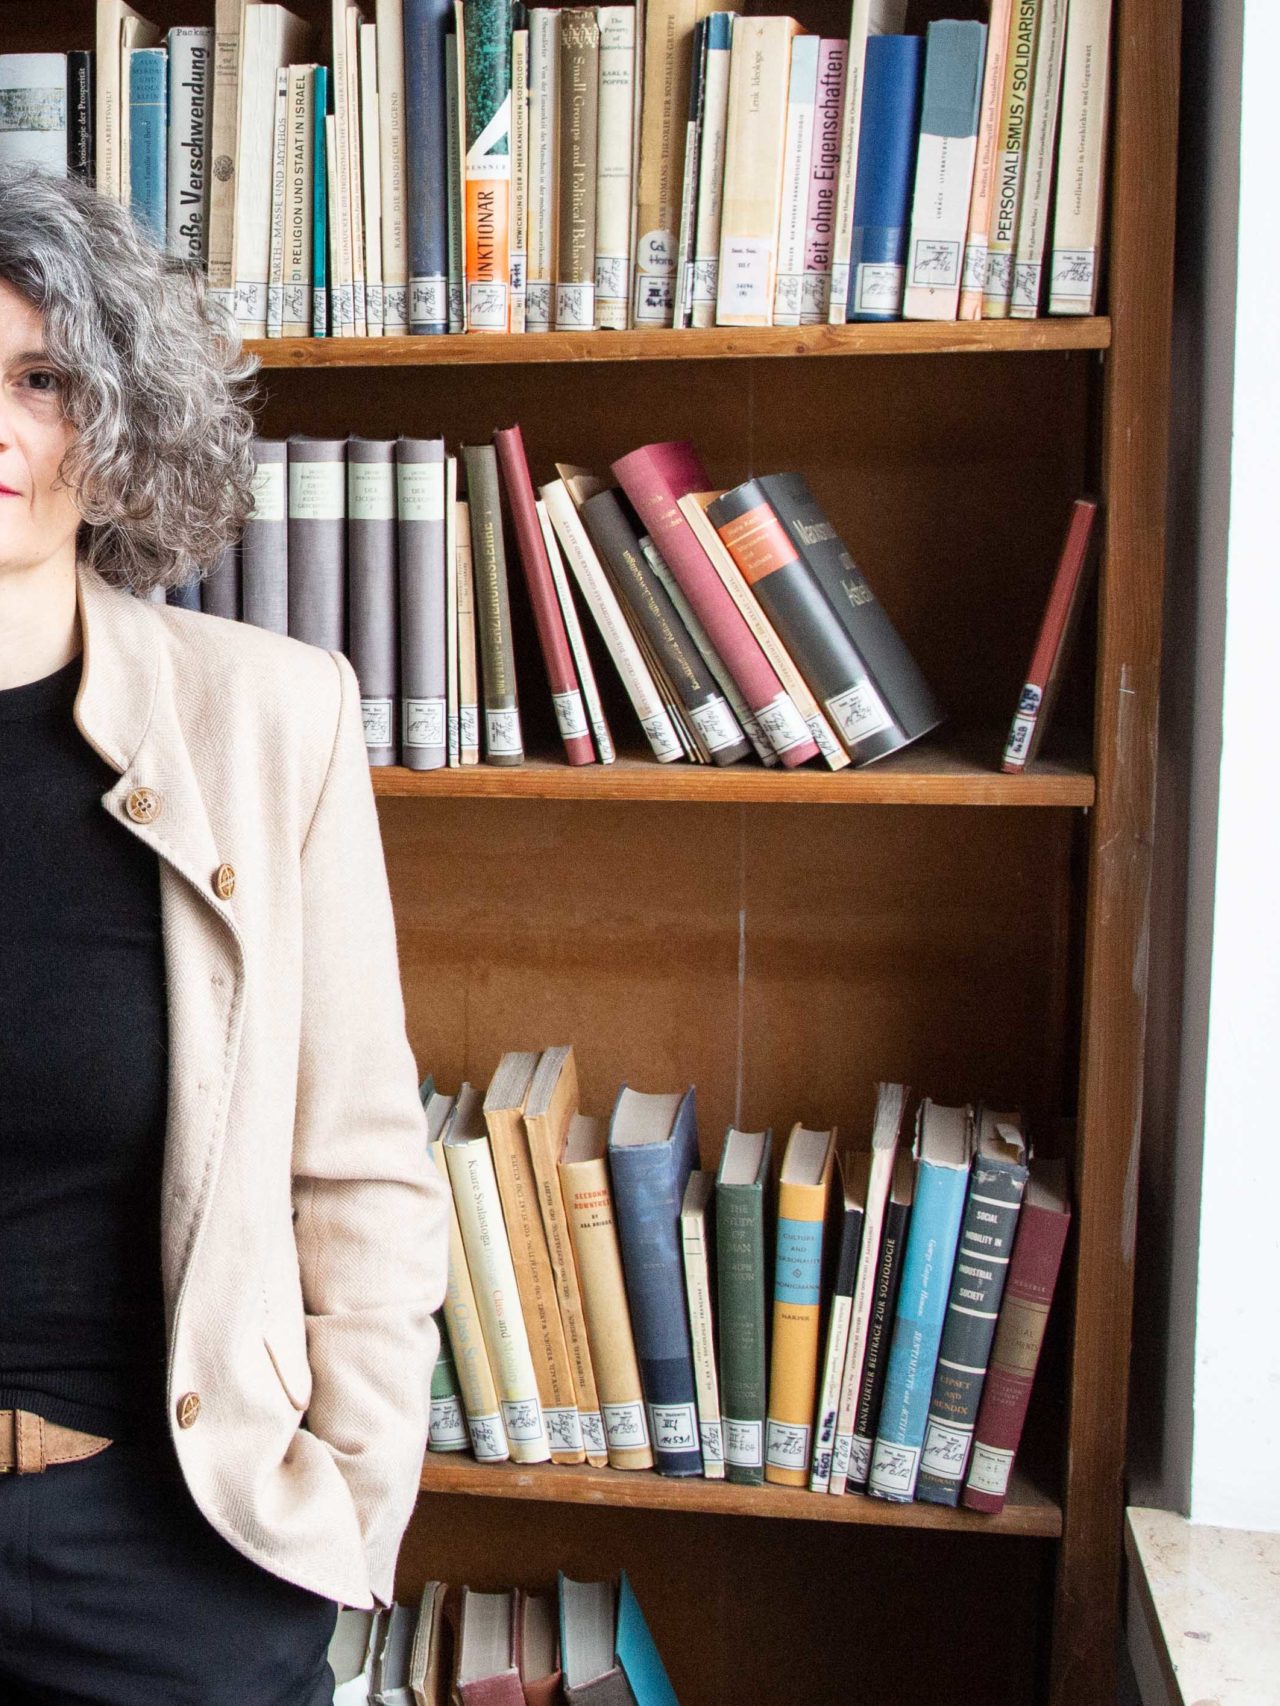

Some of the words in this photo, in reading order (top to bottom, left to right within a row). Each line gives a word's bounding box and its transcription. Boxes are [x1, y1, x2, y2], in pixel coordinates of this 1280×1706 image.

[666, 13, 675, 49] GRUPPE
[515, 52, 523, 100] SOZIOLOGIE
[540, 65, 548, 79] Von
[572, 56, 585, 91] Small
[663, 51, 673, 96] SOZIALEN
[1081, 43, 1094, 88] Gegenwart
[78, 67, 87, 109] Prosperität
[294, 75, 307, 117] ISRAEL
[540, 81, 548, 92] der
[749, 91, 759, 111] Lenk
[1081, 89, 1090, 106] und
[104, 89, 112, 144] ARBEITSWELT
[177, 46, 210, 205] Verschwendung
[539, 93, 547, 129] Einsamkeit
[571, 95, 584, 140] Groups
[662, 99, 671, 117] DER
[812, 48, 848, 180] Eigenschaften
[986, 105, 995, 121] und
[276, 118, 286, 165] MYTHOS
[295, 122, 305, 133] IN
[515, 104, 523, 173] AMERIKANISCHEN
[539, 131, 547, 142] des
[660, 119, 670, 158] THEORIE
[78, 126, 87, 166] Soziologie
[293, 137, 305, 173] STAAT
[539, 143, 547, 175] Menschen
[572, 144, 584, 167] and
[1076, 153, 1085, 163] in
[275, 171, 284, 195] UND
[992, 102, 1027, 241] PERSONALISMUS
[293, 177, 304, 203] UND
[538, 184, 546, 195] der
[572, 172, 585, 224] Political
[1071, 165, 1085, 215] Gesellschaft
[273, 200, 282, 237] MASSE
[515, 194, 523, 248] ENTWICKLUNG
[811, 187, 833, 233] ohne
[291, 206, 304, 264] RELIGION
[271, 247, 281, 282] BARTH
[572, 228, 584, 283] Behavior
[808, 239, 829, 272] Zeit
[466, 1158, 482, 1191] Kaare
[470, 1191, 493, 1247] Svalastoga
[976, 1210, 998, 1224] SOCIAL
[783, 1233, 817, 1242] CULTURE
[966, 1230, 993, 1246] MOBILITY
[994, 1238, 1003, 1248] IN
[877, 1237, 895, 1298] SOZIOLOGIE
[959, 1264, 992, 1281] INDUSTRIAL
[491, 1288, 507, 1317] Class
[874, 1300, 885, 1321] ZUR
[960, 1287, 984, 1302] SOCIETY
[497, 1317, 511, 1339] and
[903, 1330, 922, 1389] SENTIMENTS
[940, 1375, 972, 1390] LIPSET
